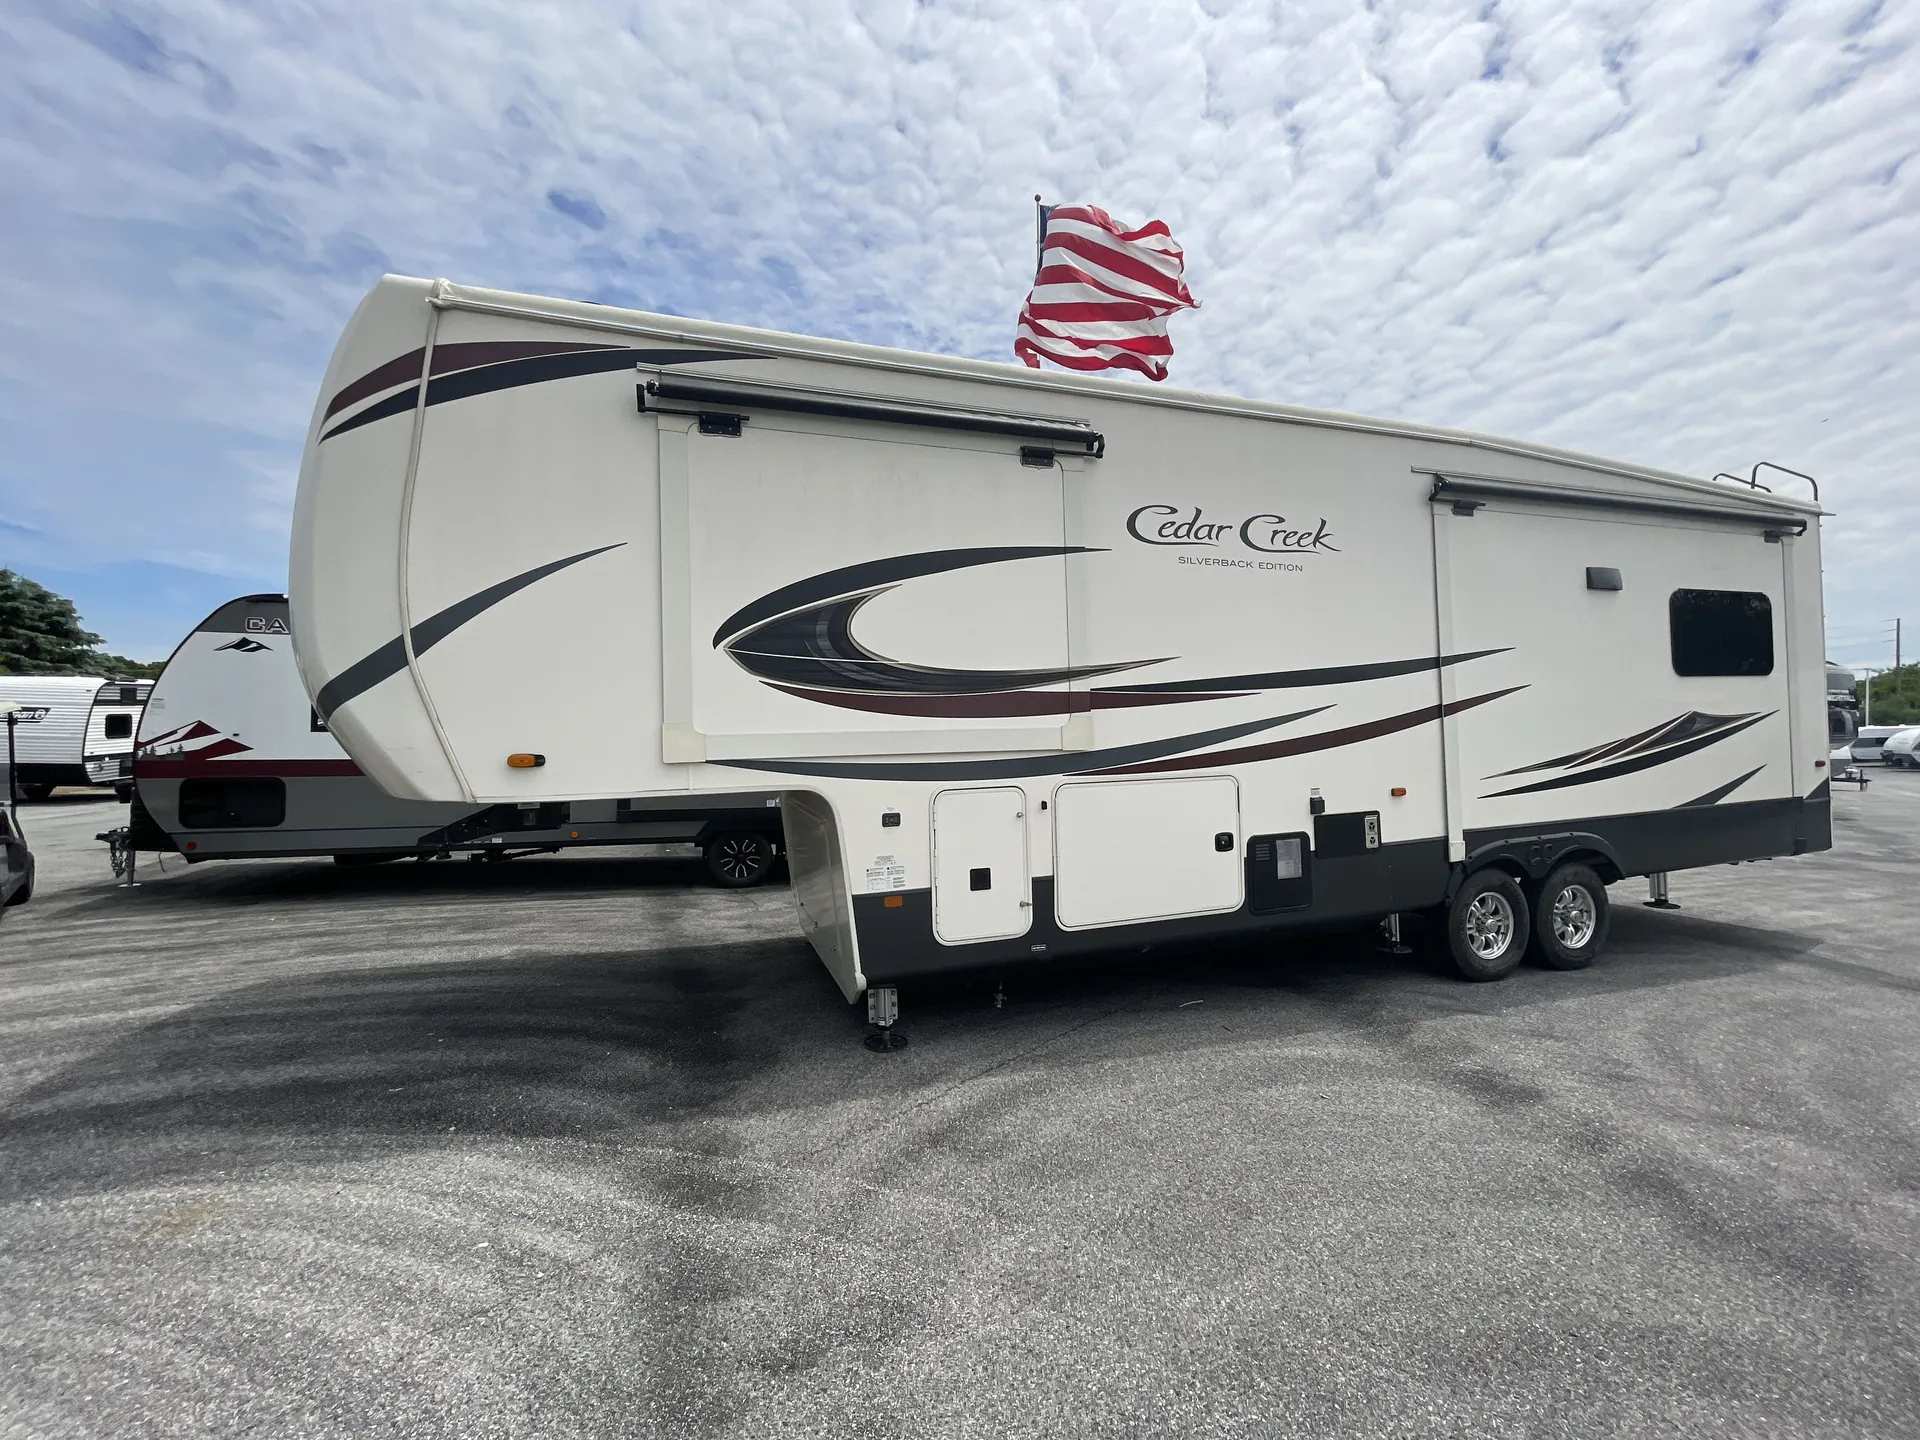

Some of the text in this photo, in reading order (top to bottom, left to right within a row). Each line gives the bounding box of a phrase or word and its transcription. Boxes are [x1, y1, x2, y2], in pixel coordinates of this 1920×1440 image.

[1126, 504, 1343, 555] Cedar Creek
[1178, 556, 1303, 572] SILVERBACK EDITION
[245, 616, 289, 634] CA
